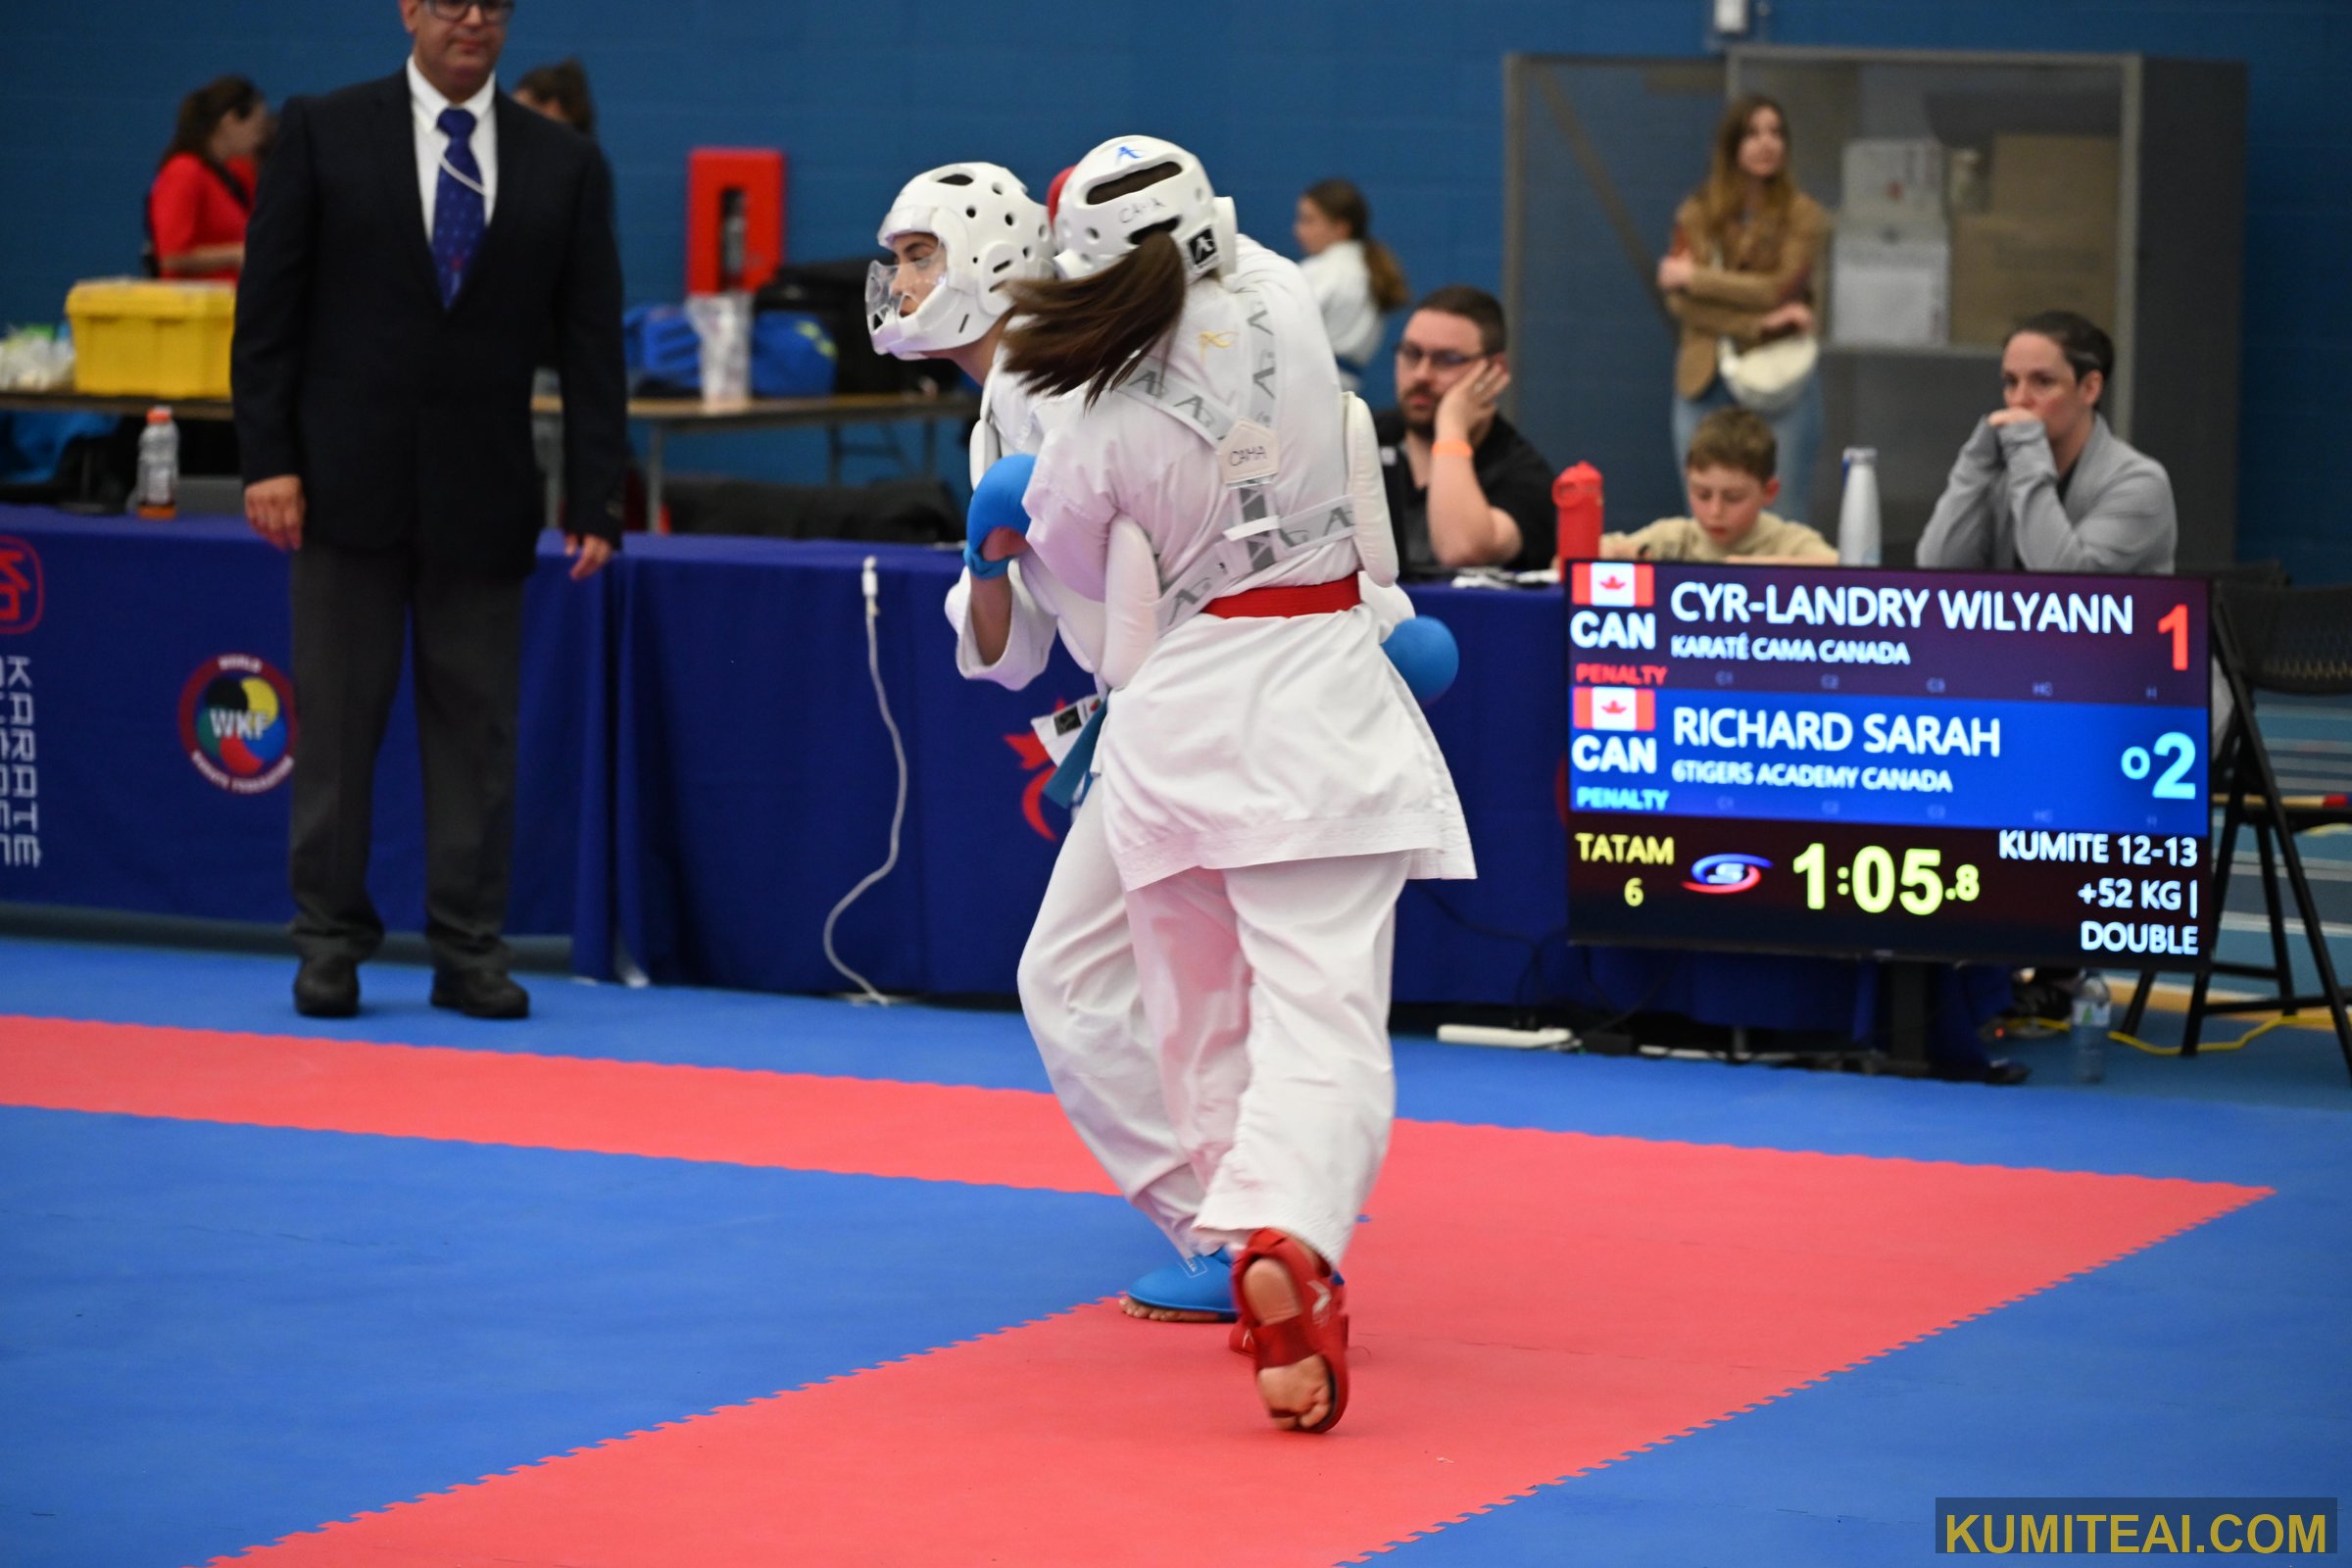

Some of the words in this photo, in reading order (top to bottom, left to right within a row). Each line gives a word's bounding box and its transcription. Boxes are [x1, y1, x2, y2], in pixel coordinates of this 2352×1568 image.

[1671, 582, 1930, 628] CYR-LANDRY
[1937, 589, 2133, 635] WILYANN
[1570, 611, 1656, 650] CAN
[2157, 604, 2188, 671] 1
[1671, 632, 1749, 660] KARATÉ
[1751, 638, 1817, 662] CAMA
[1818, 639, 1911, 665] CANADA
[1576, 662, 1668, 686] PENALTY
[209, 708, 268, 741] WKF
[1673, 707, 1853, 752] RICHARD
[1863, 712, 2000, 758] SARAH
[1571, 735, 1657, 774] CAN
[1671, 760, 1754, 785] 6TIGERS
[1755, 763, 1860, 789] ACADEMY
[1861, 766, 1953, 793] CANADA
[1577, 787, 1670, 810] PENALTY
[1574, 832, 1675, 865] TATAM
[1999, 829, 2110, 863] KUMITE
[2117, 834, 2198, 867] 12-13
[1624, 877, 1644, 907] 6
[2078, 877, 2133, 908] +52
[2140, 879, 2181, 910] KG
[2081, 920, 2199, 956] DOUBLE
